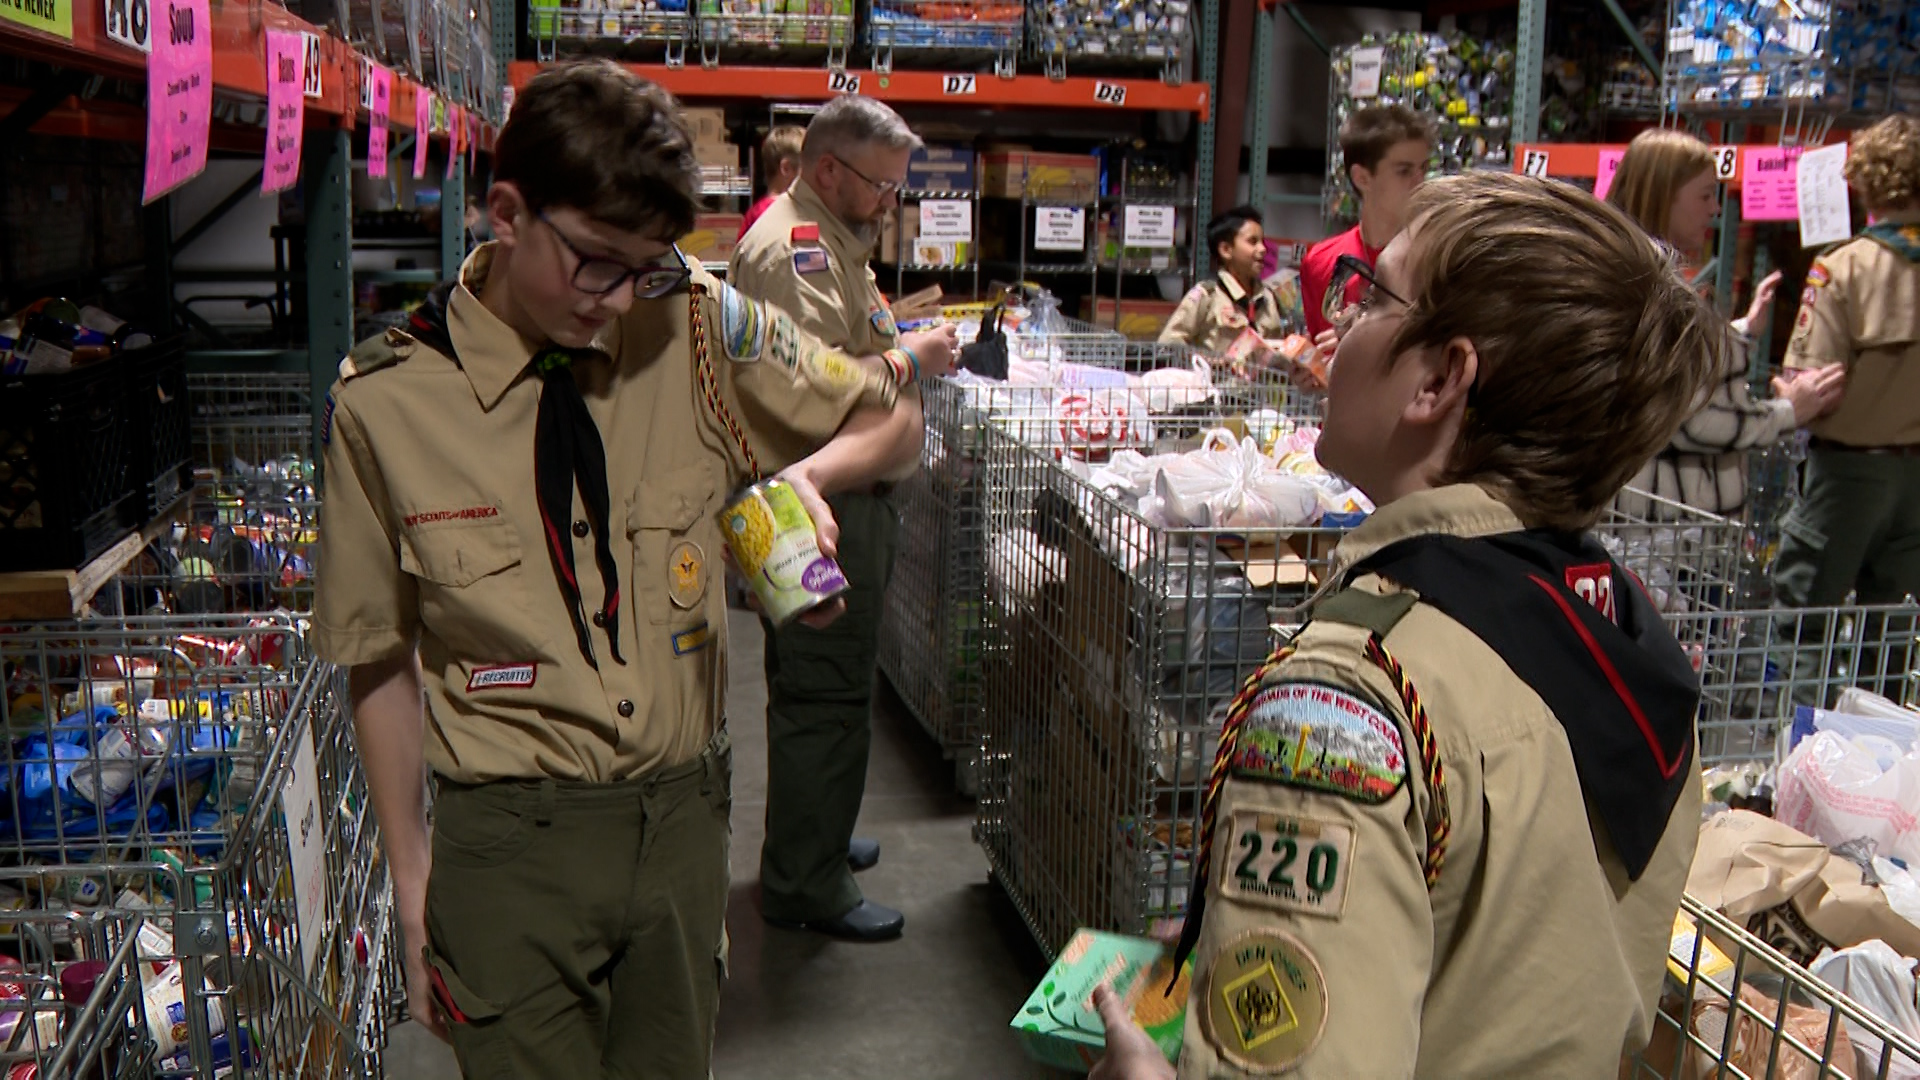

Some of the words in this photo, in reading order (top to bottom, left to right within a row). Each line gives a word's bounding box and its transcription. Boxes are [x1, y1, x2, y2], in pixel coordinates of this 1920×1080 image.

[169, 2, 194, 45] Soup
[303, 35, 320, 93] A9
[830, 73, 858, 92] D6
[946, 76, 973, 93] D7
[1097, 83, 1124, 103] D8
[1525, 152, 1546, 177] F7
[420, 510, 452, 524] SCOUTS
[460, 507, 498, 520] AMERICA
[1292, 686, 1309, 700] OF
[1311, 686, 1334, 704] THE
[1334, 694, 1369, 719] WEST
[1235, 829, 1339, 893] 220
